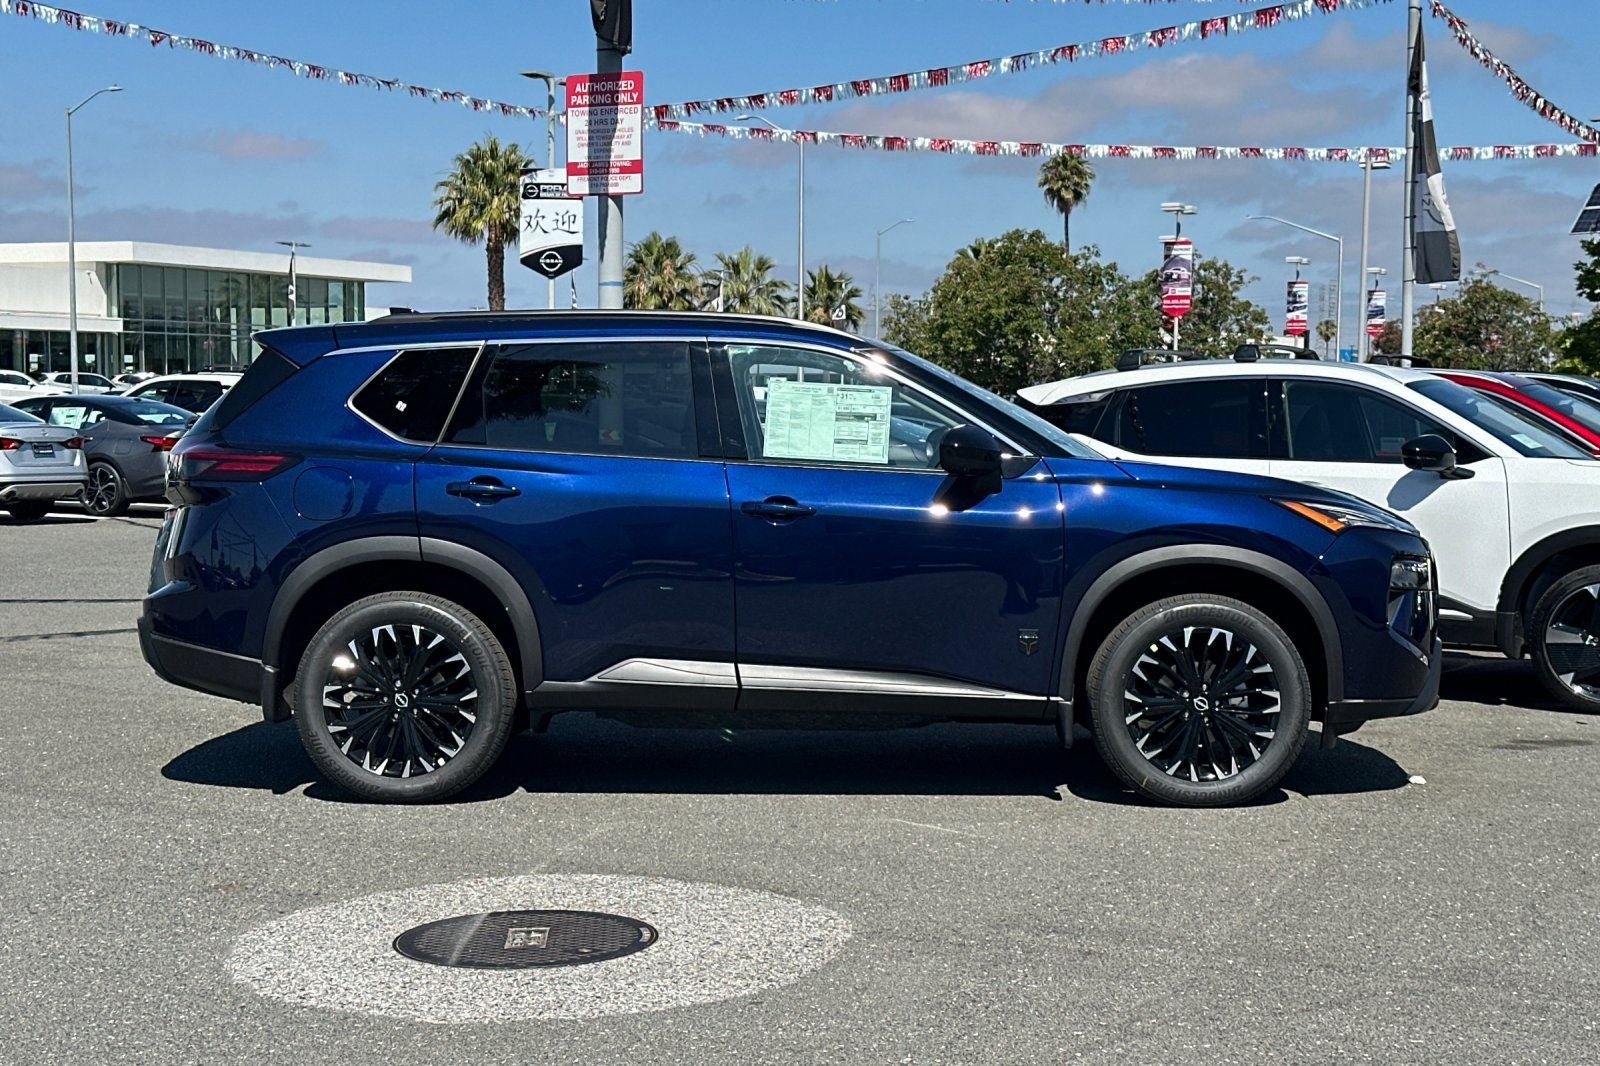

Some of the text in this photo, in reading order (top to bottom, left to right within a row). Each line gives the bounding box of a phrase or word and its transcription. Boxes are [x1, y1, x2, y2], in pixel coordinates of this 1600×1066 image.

[575, 80, 634, 93] AUTHORIZED
[571, 92, 639, 105] PARKING ONLY
[570, 107, 639, 117] TOWING ENFORCED
[523, 208, 580, 234] 欢迎
